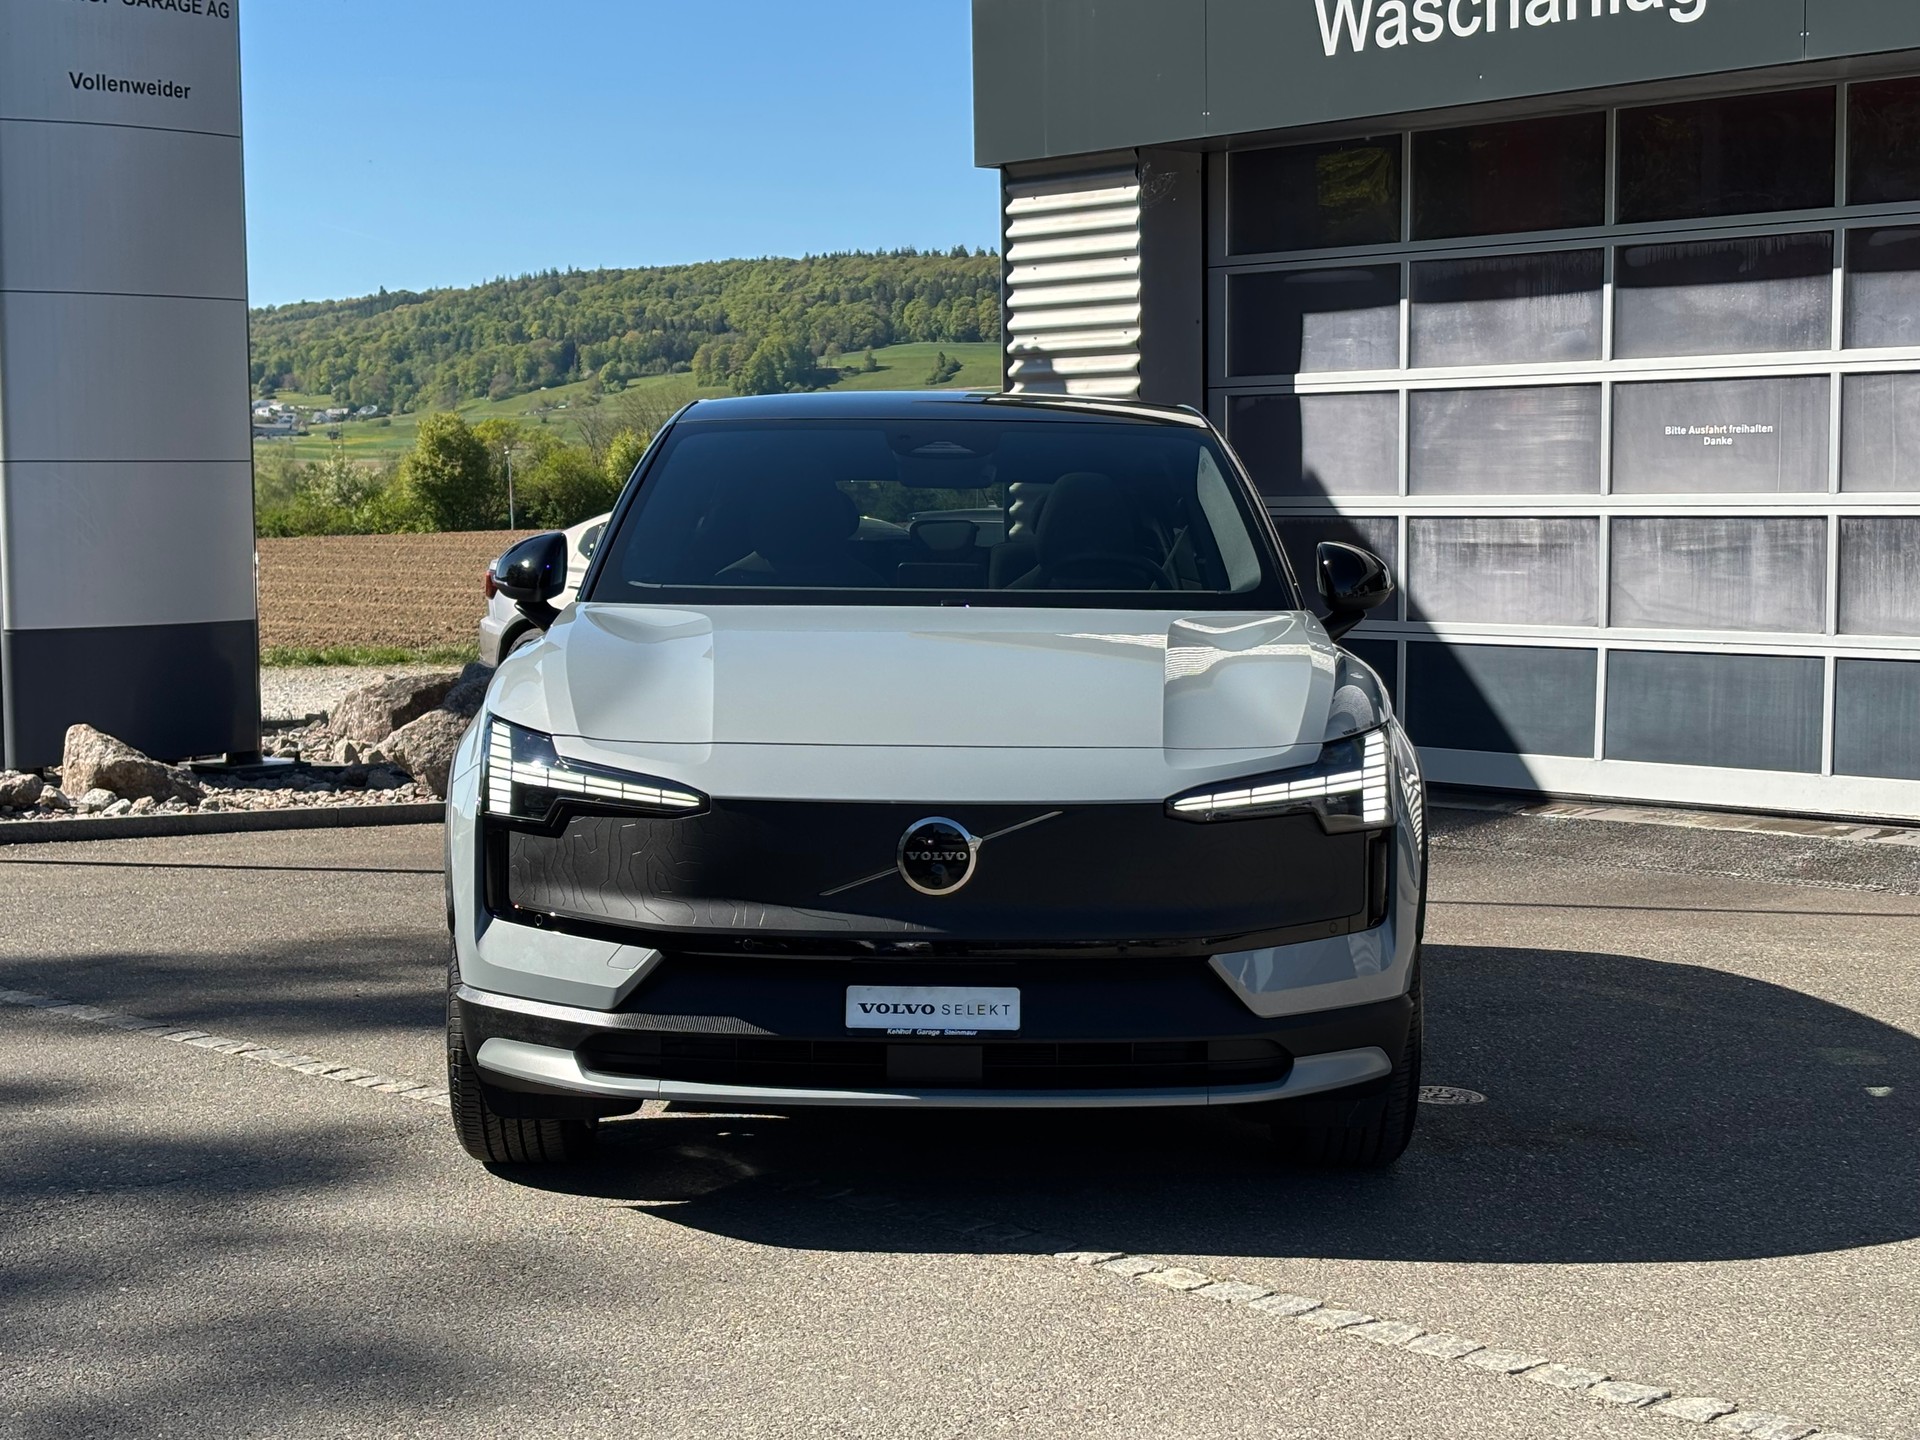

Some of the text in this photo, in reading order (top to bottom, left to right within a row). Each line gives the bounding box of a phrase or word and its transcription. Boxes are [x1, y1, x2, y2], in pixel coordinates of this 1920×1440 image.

[206, 1, 230, 19] AG
[69, 71, 191, 99] Vollenweider
[1664, 426, 1687, 435] Bitte
[1688, 425, 1727, 435] Ausfahrt
[1703, 436, 1733, 446] Danke
[906, 851, 968, 861] VOLVO
[858, 1003, 1011, 1016] VOLVO SELEKT
